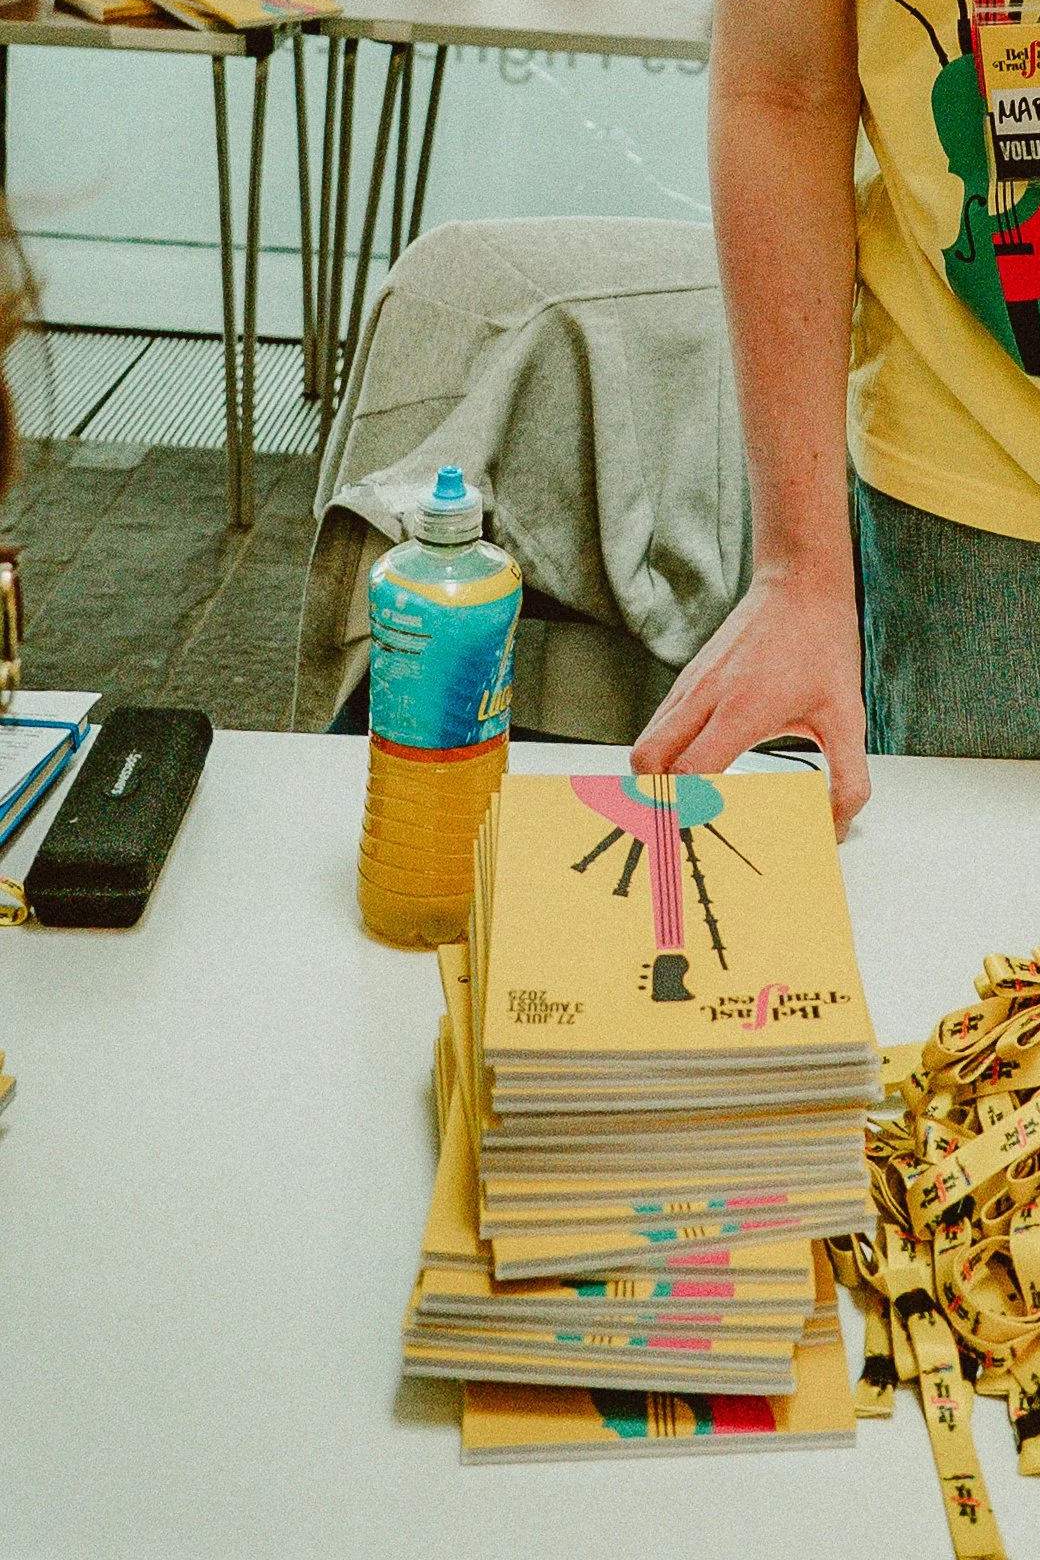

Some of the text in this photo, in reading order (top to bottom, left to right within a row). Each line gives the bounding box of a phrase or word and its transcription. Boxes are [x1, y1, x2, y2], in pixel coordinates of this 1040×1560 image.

[508, 990, 546, 1000] 2025
[507, 1000, 583, 1013] 3 AUGUST
[700, 984, 820, 1030] Belfast
[558, 1013, 575, 1025] 27
